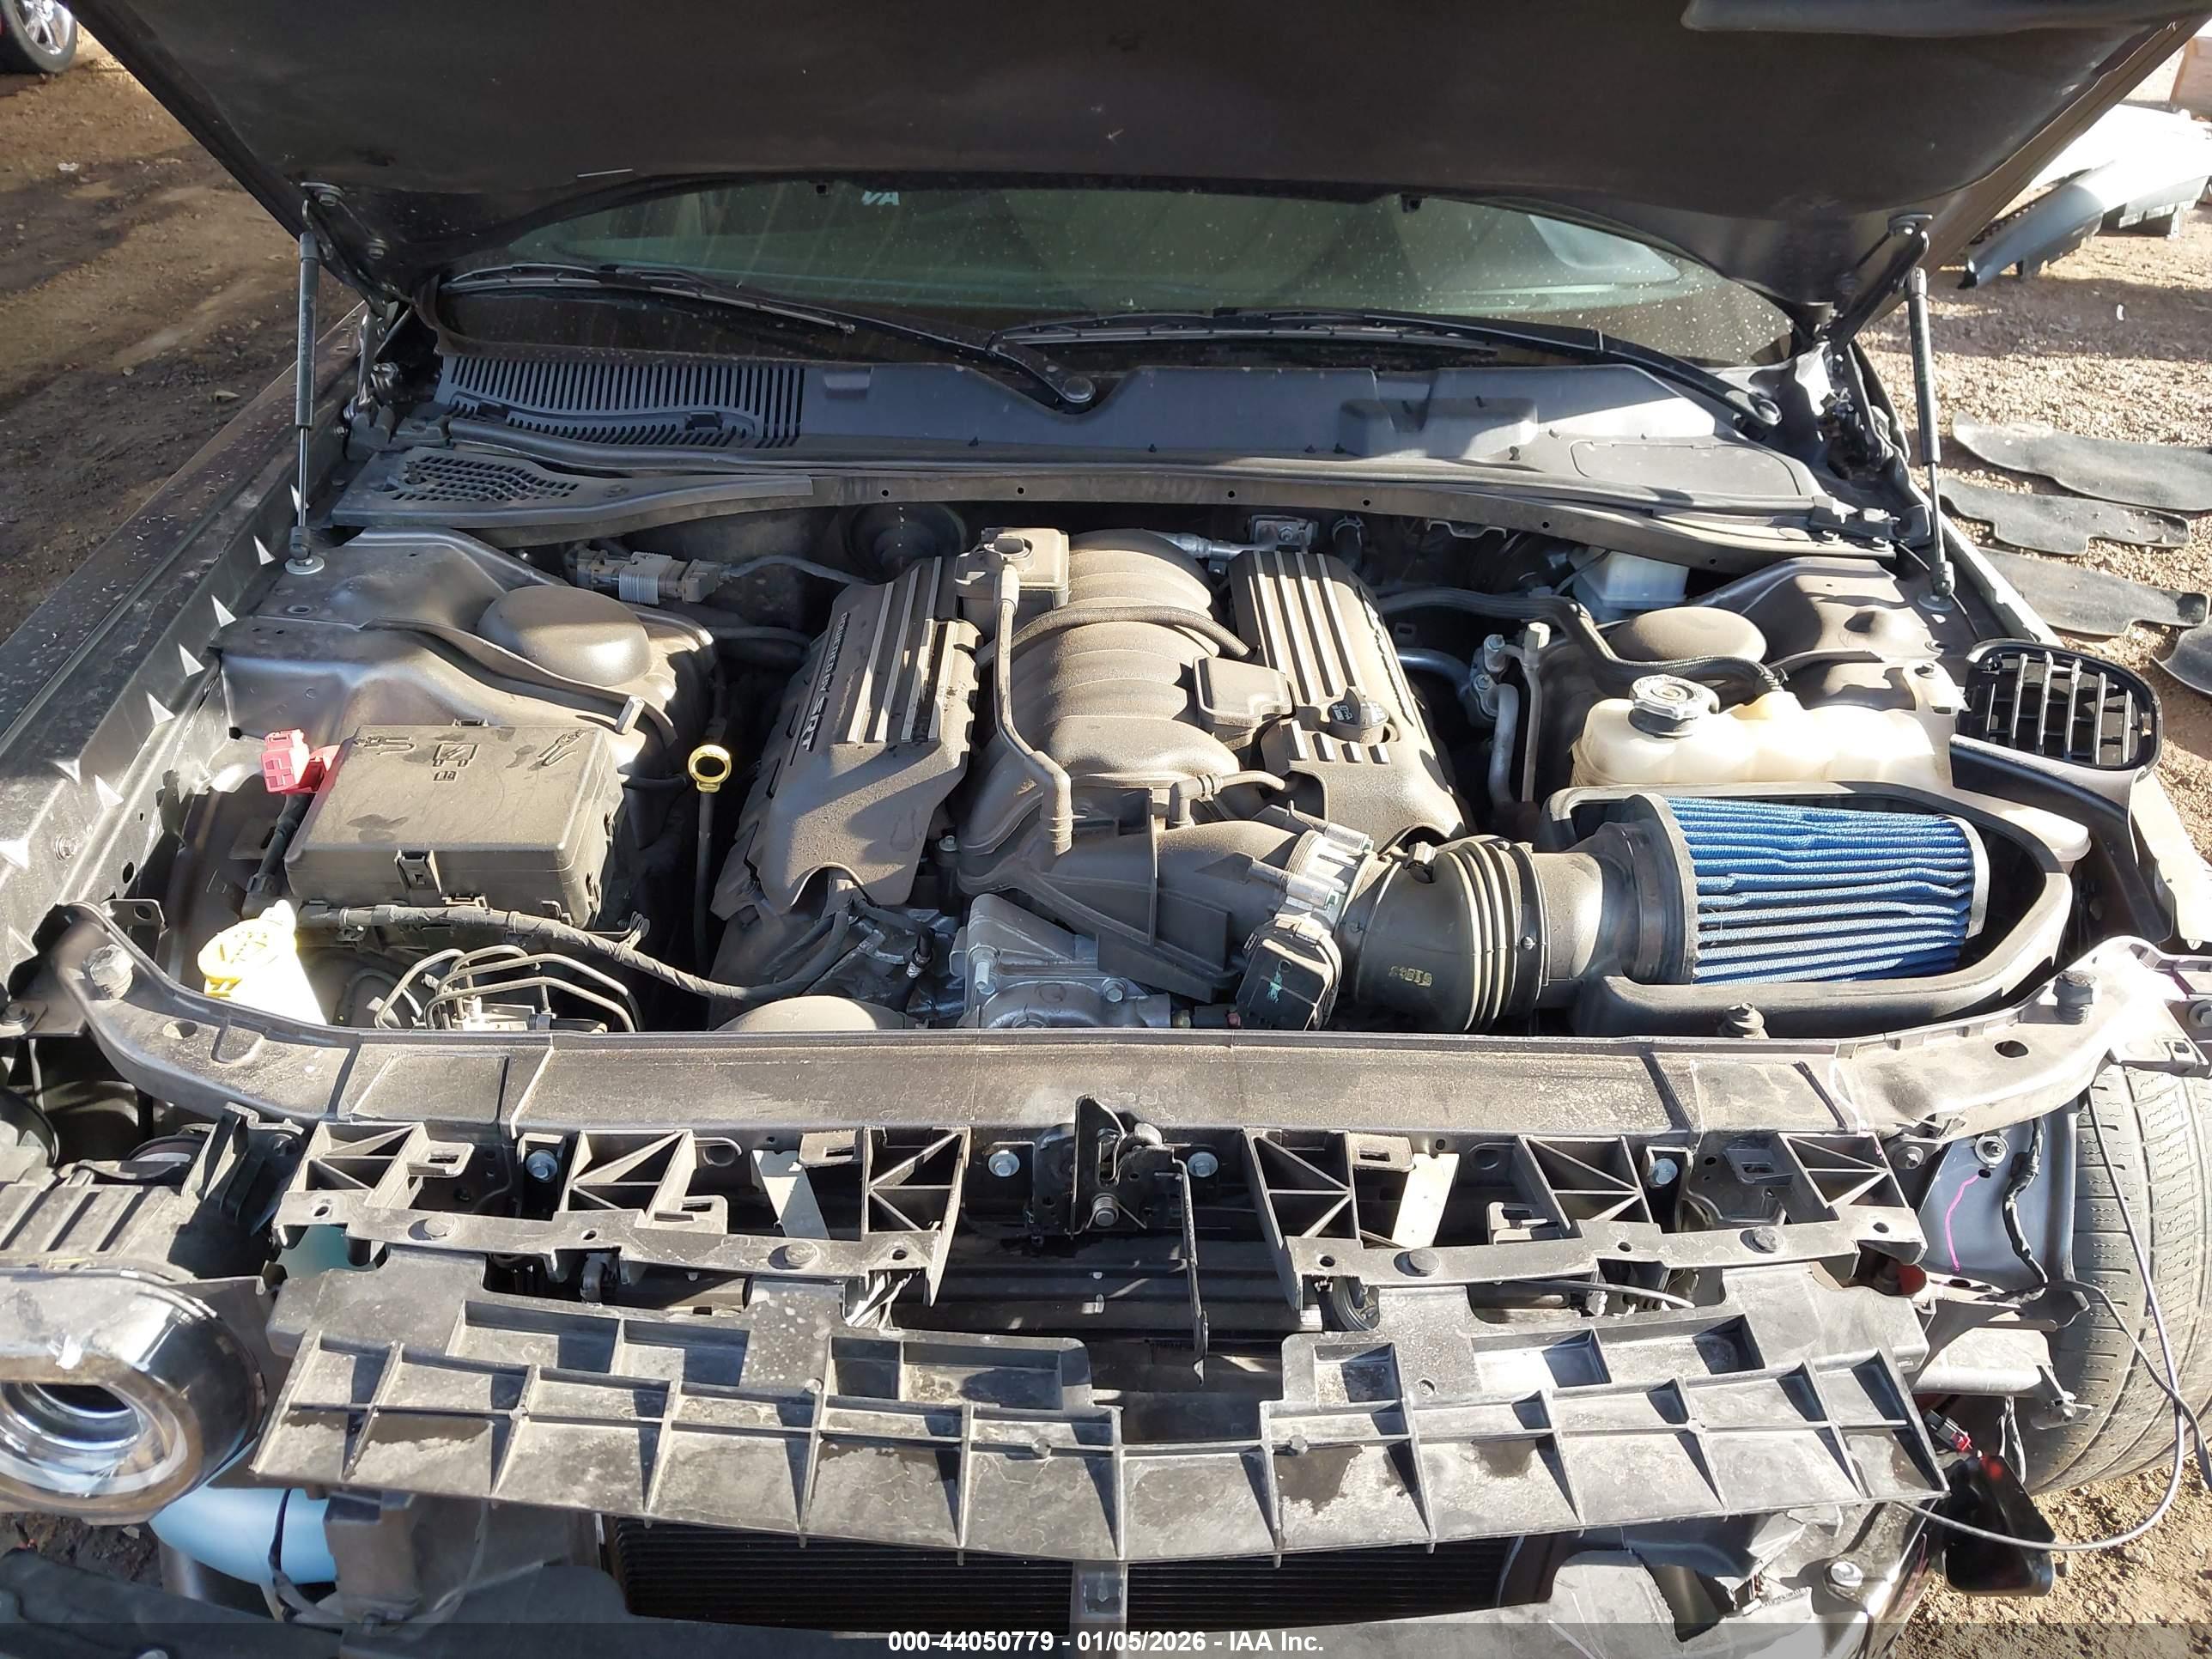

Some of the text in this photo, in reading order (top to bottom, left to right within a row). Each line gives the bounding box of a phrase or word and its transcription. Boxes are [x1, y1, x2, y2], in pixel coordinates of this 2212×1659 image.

[801, 611, 848, 751] POWERED BY SRT
